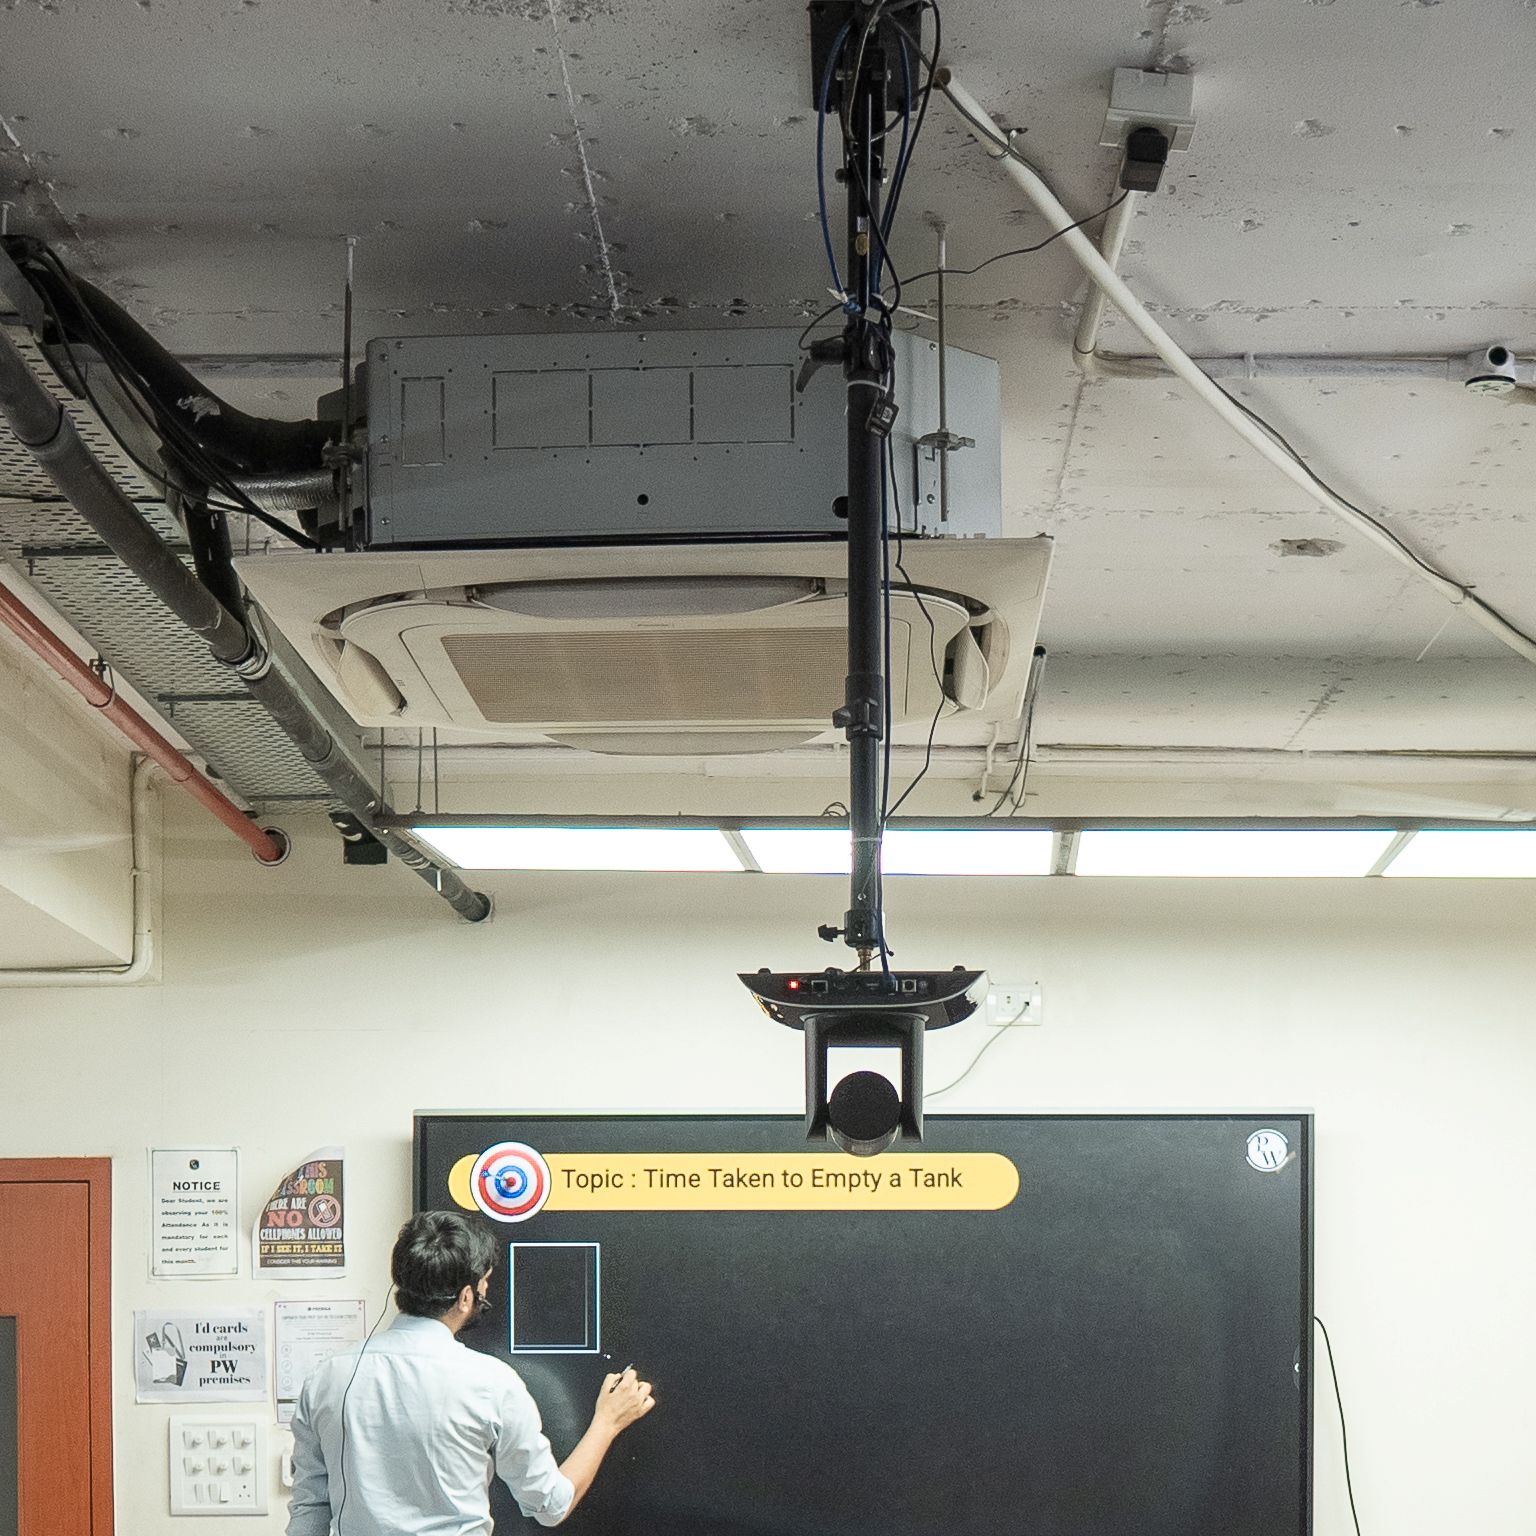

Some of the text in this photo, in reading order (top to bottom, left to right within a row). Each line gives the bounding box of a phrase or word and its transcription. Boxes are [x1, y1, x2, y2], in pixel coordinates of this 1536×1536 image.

[173, 1181, 221, 1191] NOTICE
[561, 1168, 624, 1193] Topic
[644, 1168, 701, 1188] Time
[708, 1168, 775, 1188] Taken
[782, 1169, 803, 1188] to
[811, 1168, 881, 1193] Empty
[889, 1173, 901, 1188] a
[909, 1168, 963, 1188] Tank
[267, 1210, 303, 1227] NO
[213, 1321, 248, 1334] cards
[189, 1341, 256, 1354] compulsory
[210, 1360, 238, 1373] PW
[199, 1374, 251, 1387] premises
